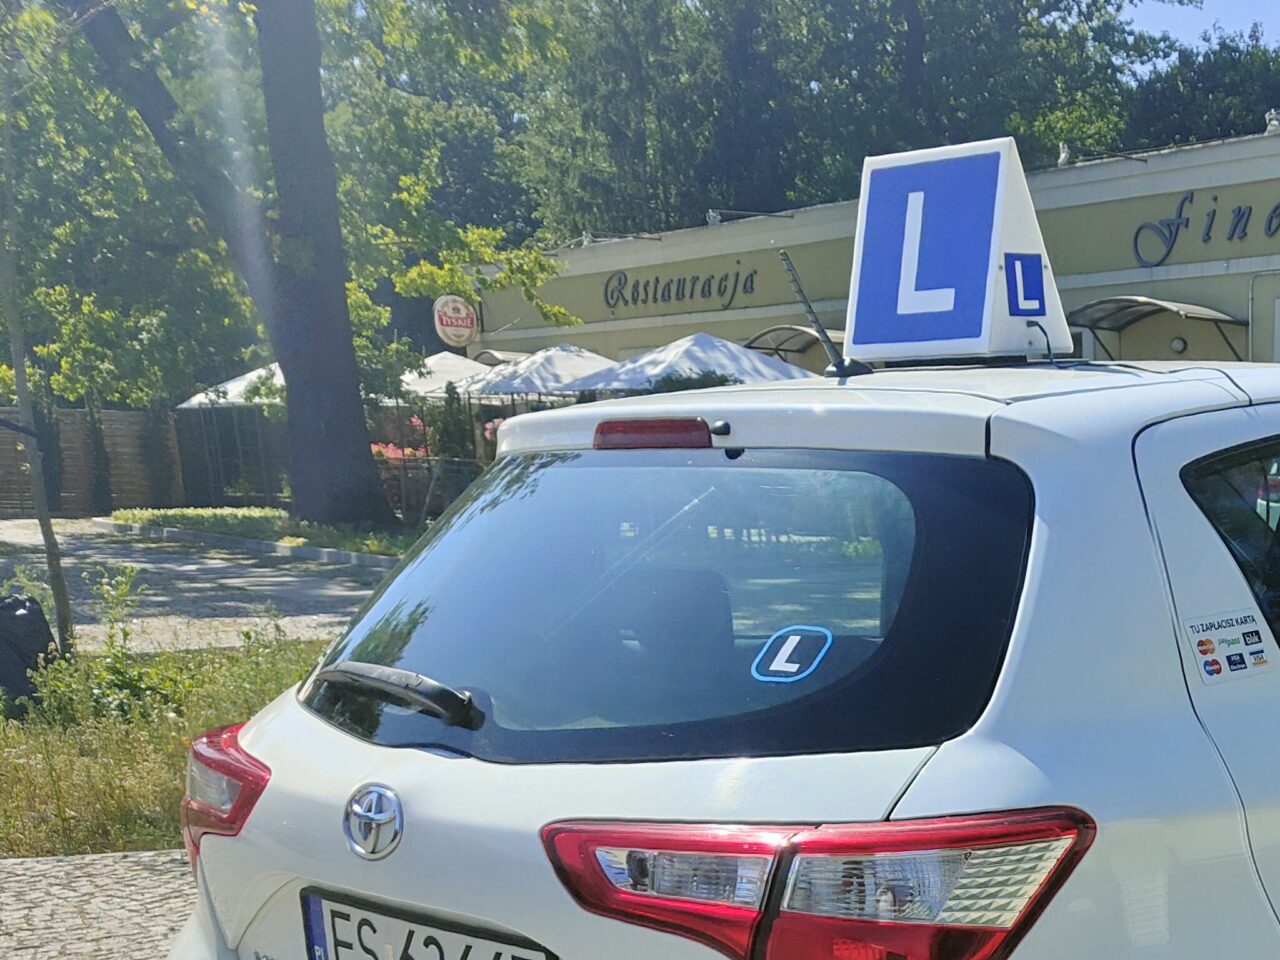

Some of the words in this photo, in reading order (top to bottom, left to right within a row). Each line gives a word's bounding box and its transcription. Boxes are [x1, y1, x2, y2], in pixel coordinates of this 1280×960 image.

[896, 191, 955, 314] L
[605, 260, 757, 310] Restauracja
[1015, 260, 1040, 309] L
[442, 316, 473, 327] TYSKIE
[1189, 624, 1200, 634] TU
[1235, 615, 1257, 625] KARTĄ
[769, 636, 801, 672] L
